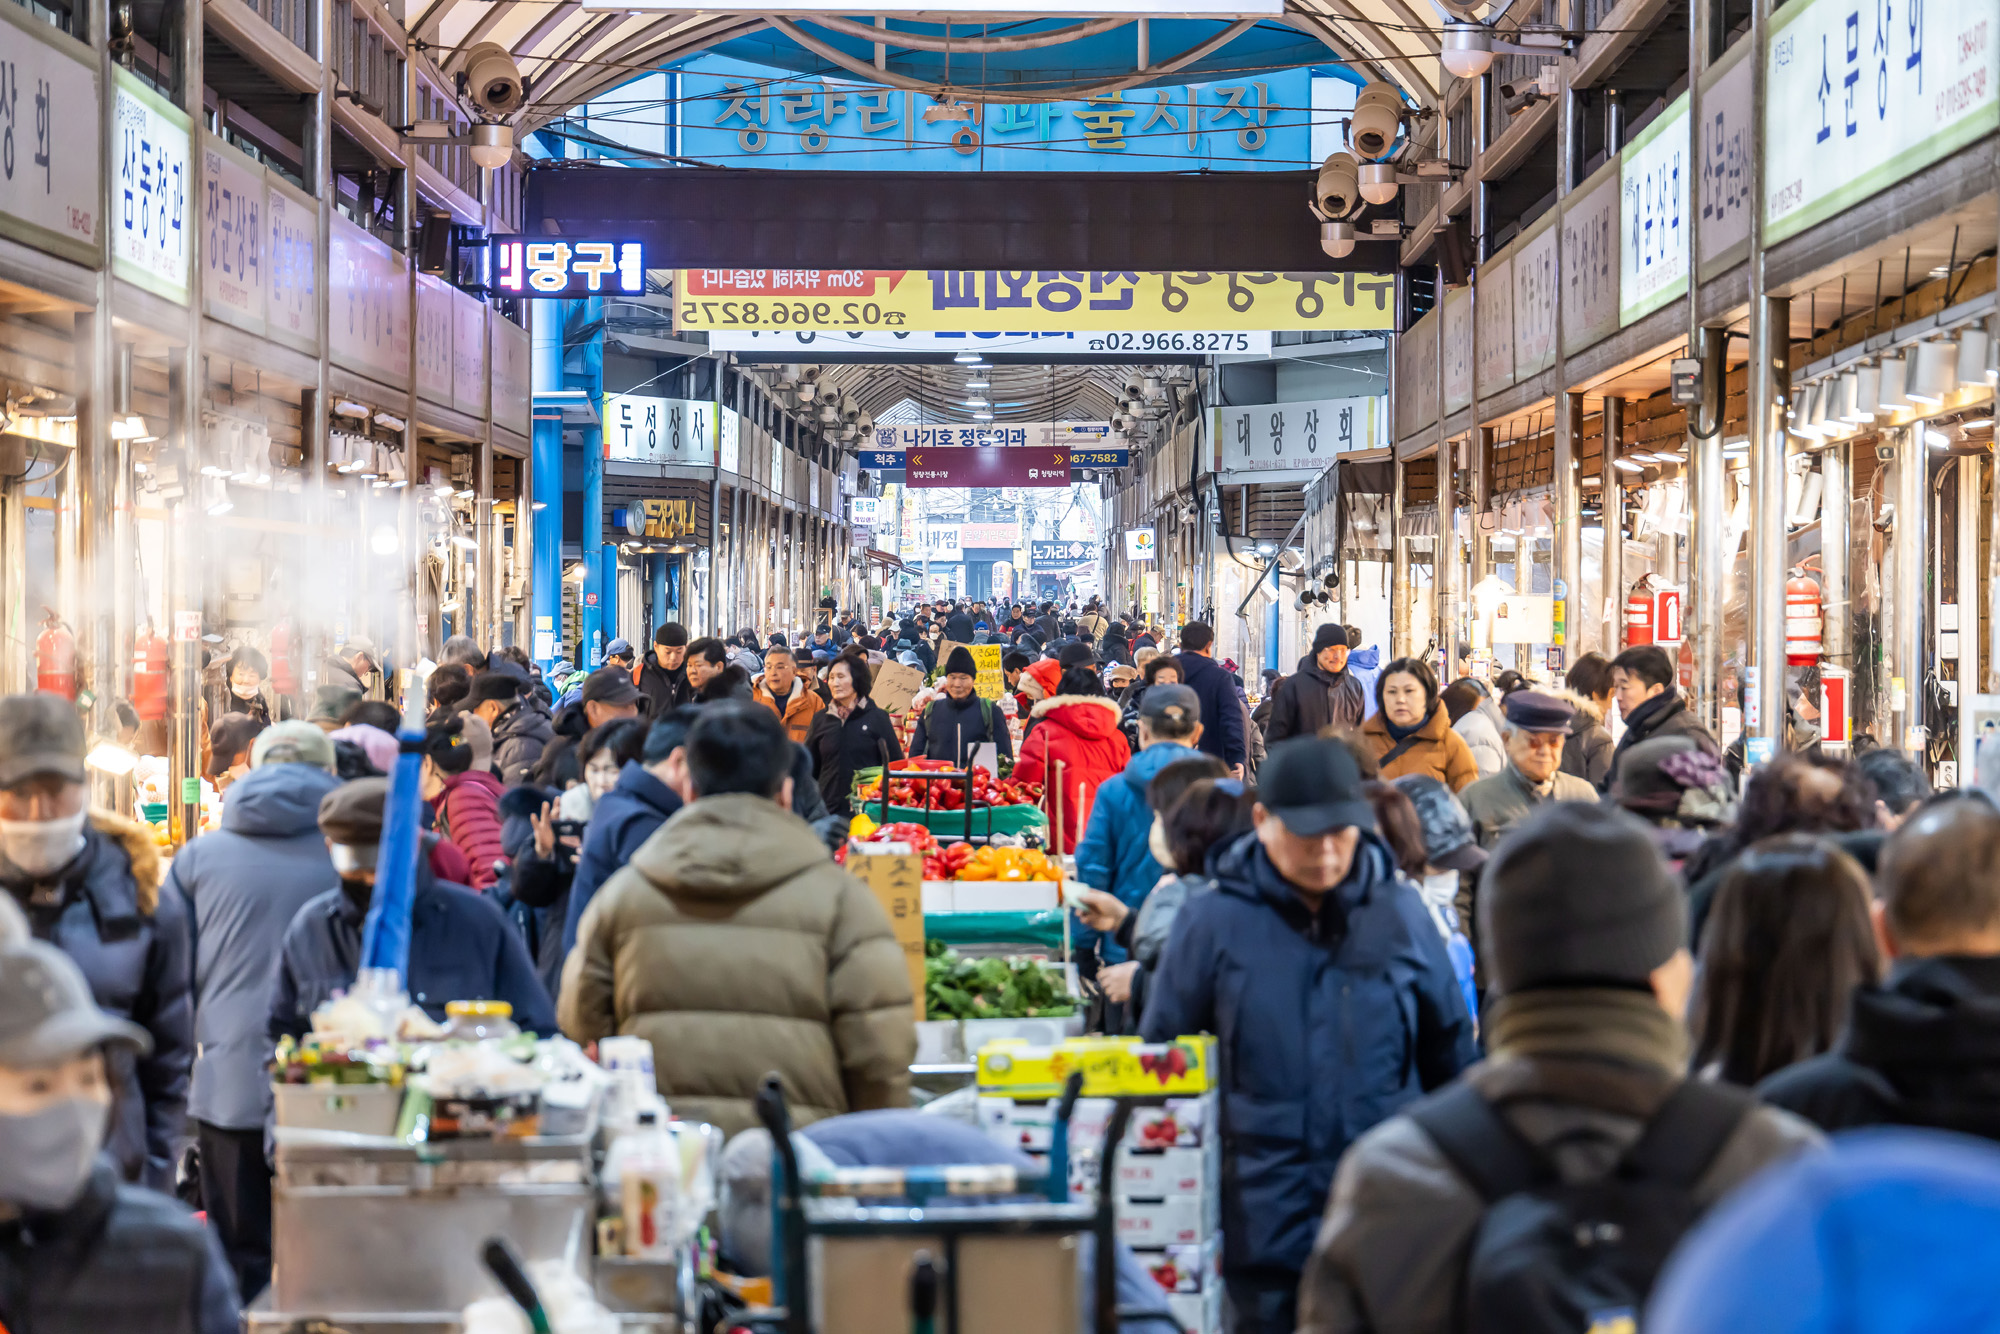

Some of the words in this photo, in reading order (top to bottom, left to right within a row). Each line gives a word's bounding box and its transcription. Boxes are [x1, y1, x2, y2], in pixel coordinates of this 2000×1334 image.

[122, 128, 184, 257] 삼동청과
[206, 179, 259, 287] 장군상회
[1106, 331, 1250, 352] 02.966.8275
[620, 403, 705, 452] 두성상사
[903, 428, 955, 447] 나기호
[1236, 406, 1353, 457] 대왕상회
[874, 453, 897, 466] 척추
[1032, 544, 1068, 560] 노가리
